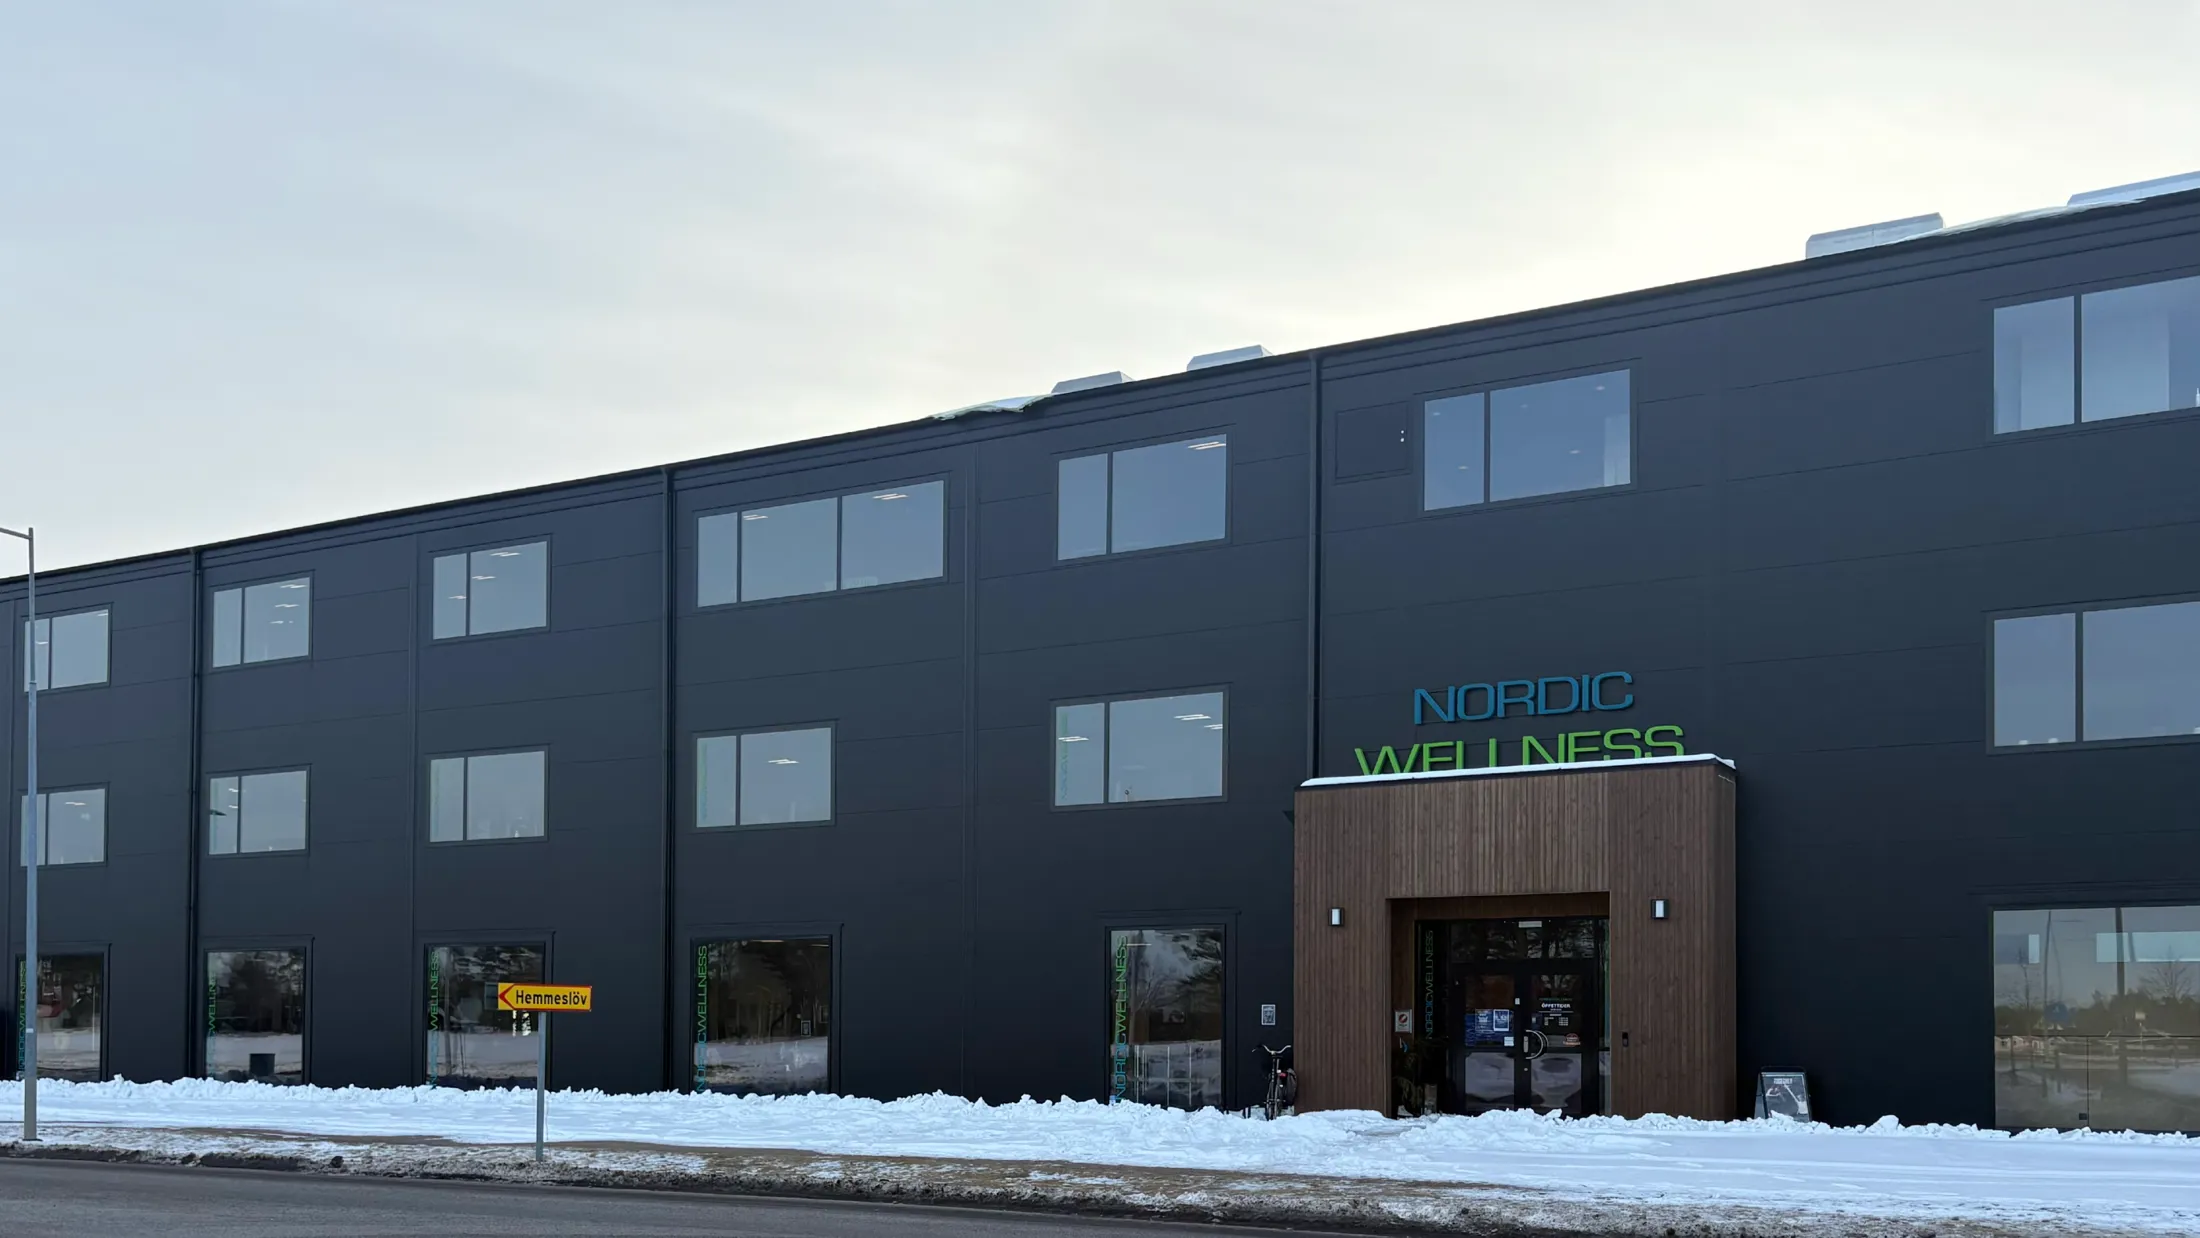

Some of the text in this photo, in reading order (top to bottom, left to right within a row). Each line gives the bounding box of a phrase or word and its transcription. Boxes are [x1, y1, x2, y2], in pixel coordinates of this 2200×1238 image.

[1413, 671, 1634, 725] NORDIC
[1354, 725, 1685, 776] WELLNESS
[516, 989, 587, 1006] Hemmeslöv
